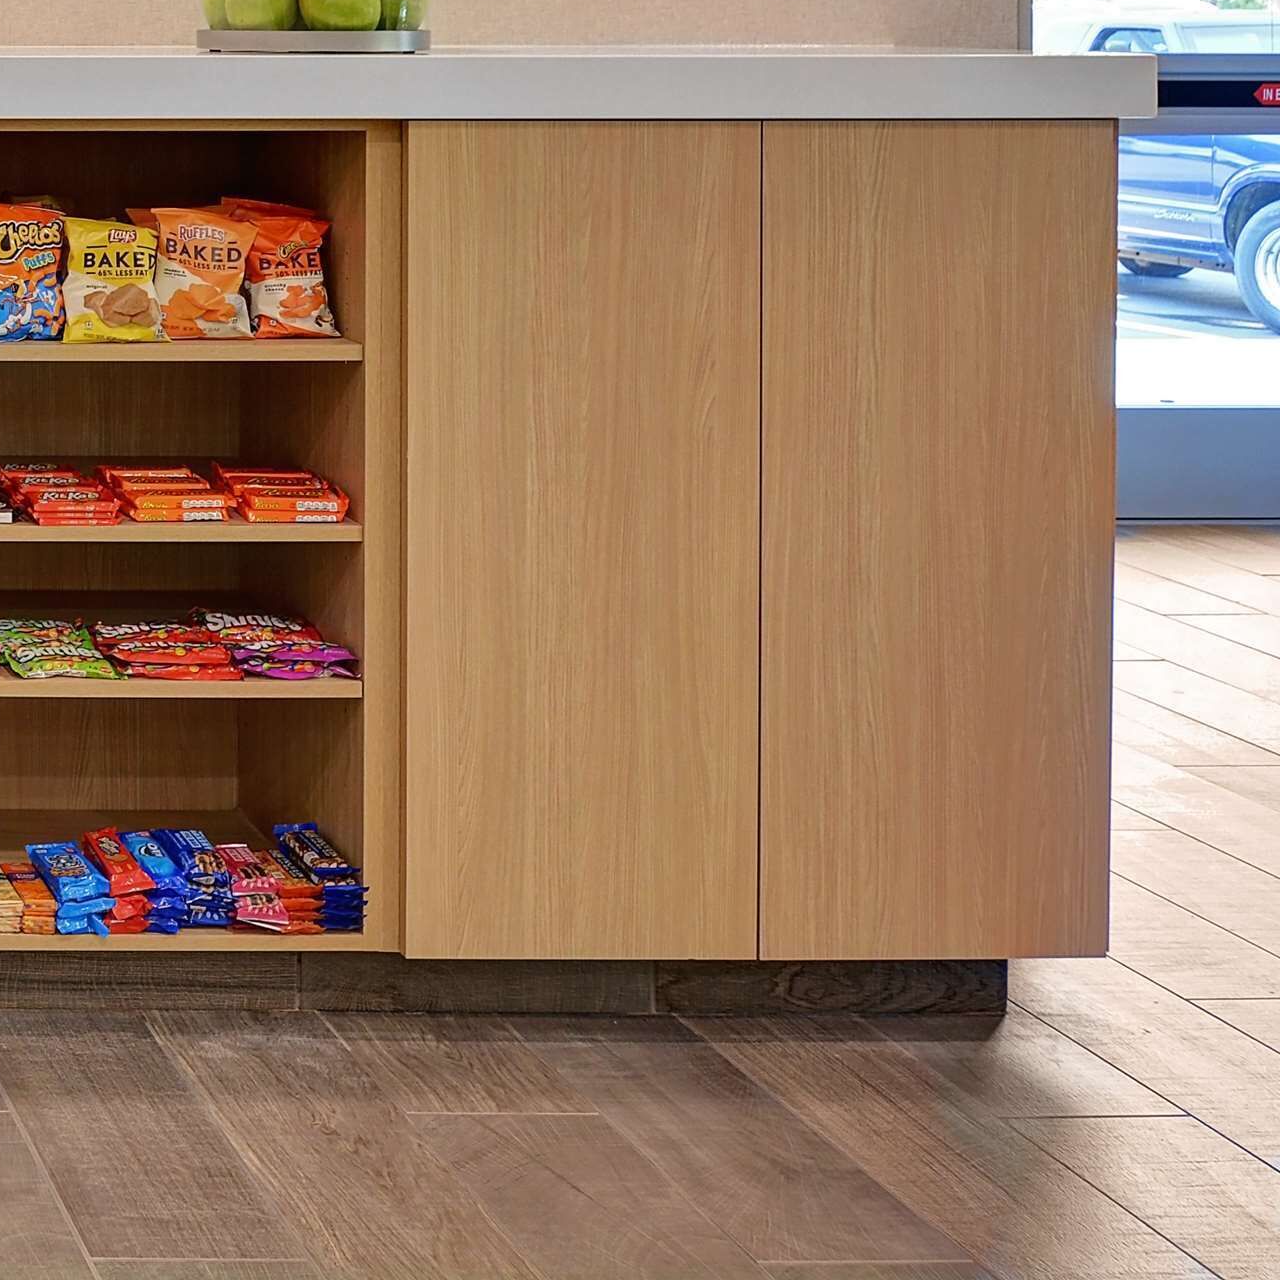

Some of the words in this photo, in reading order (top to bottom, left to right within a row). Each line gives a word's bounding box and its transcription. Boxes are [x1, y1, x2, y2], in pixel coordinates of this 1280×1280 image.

[1263, 88, 1273, 101] IN
[179, 226, 225, 242] RUFFLES
[166, 238, 242, 263] BAKED
[23, 252, 56, 270] Puffs
[84, 251, 157, 269] BAKED
[193, 261, 211, 270] LESS
[259, 252, 320, 270] BAKE
